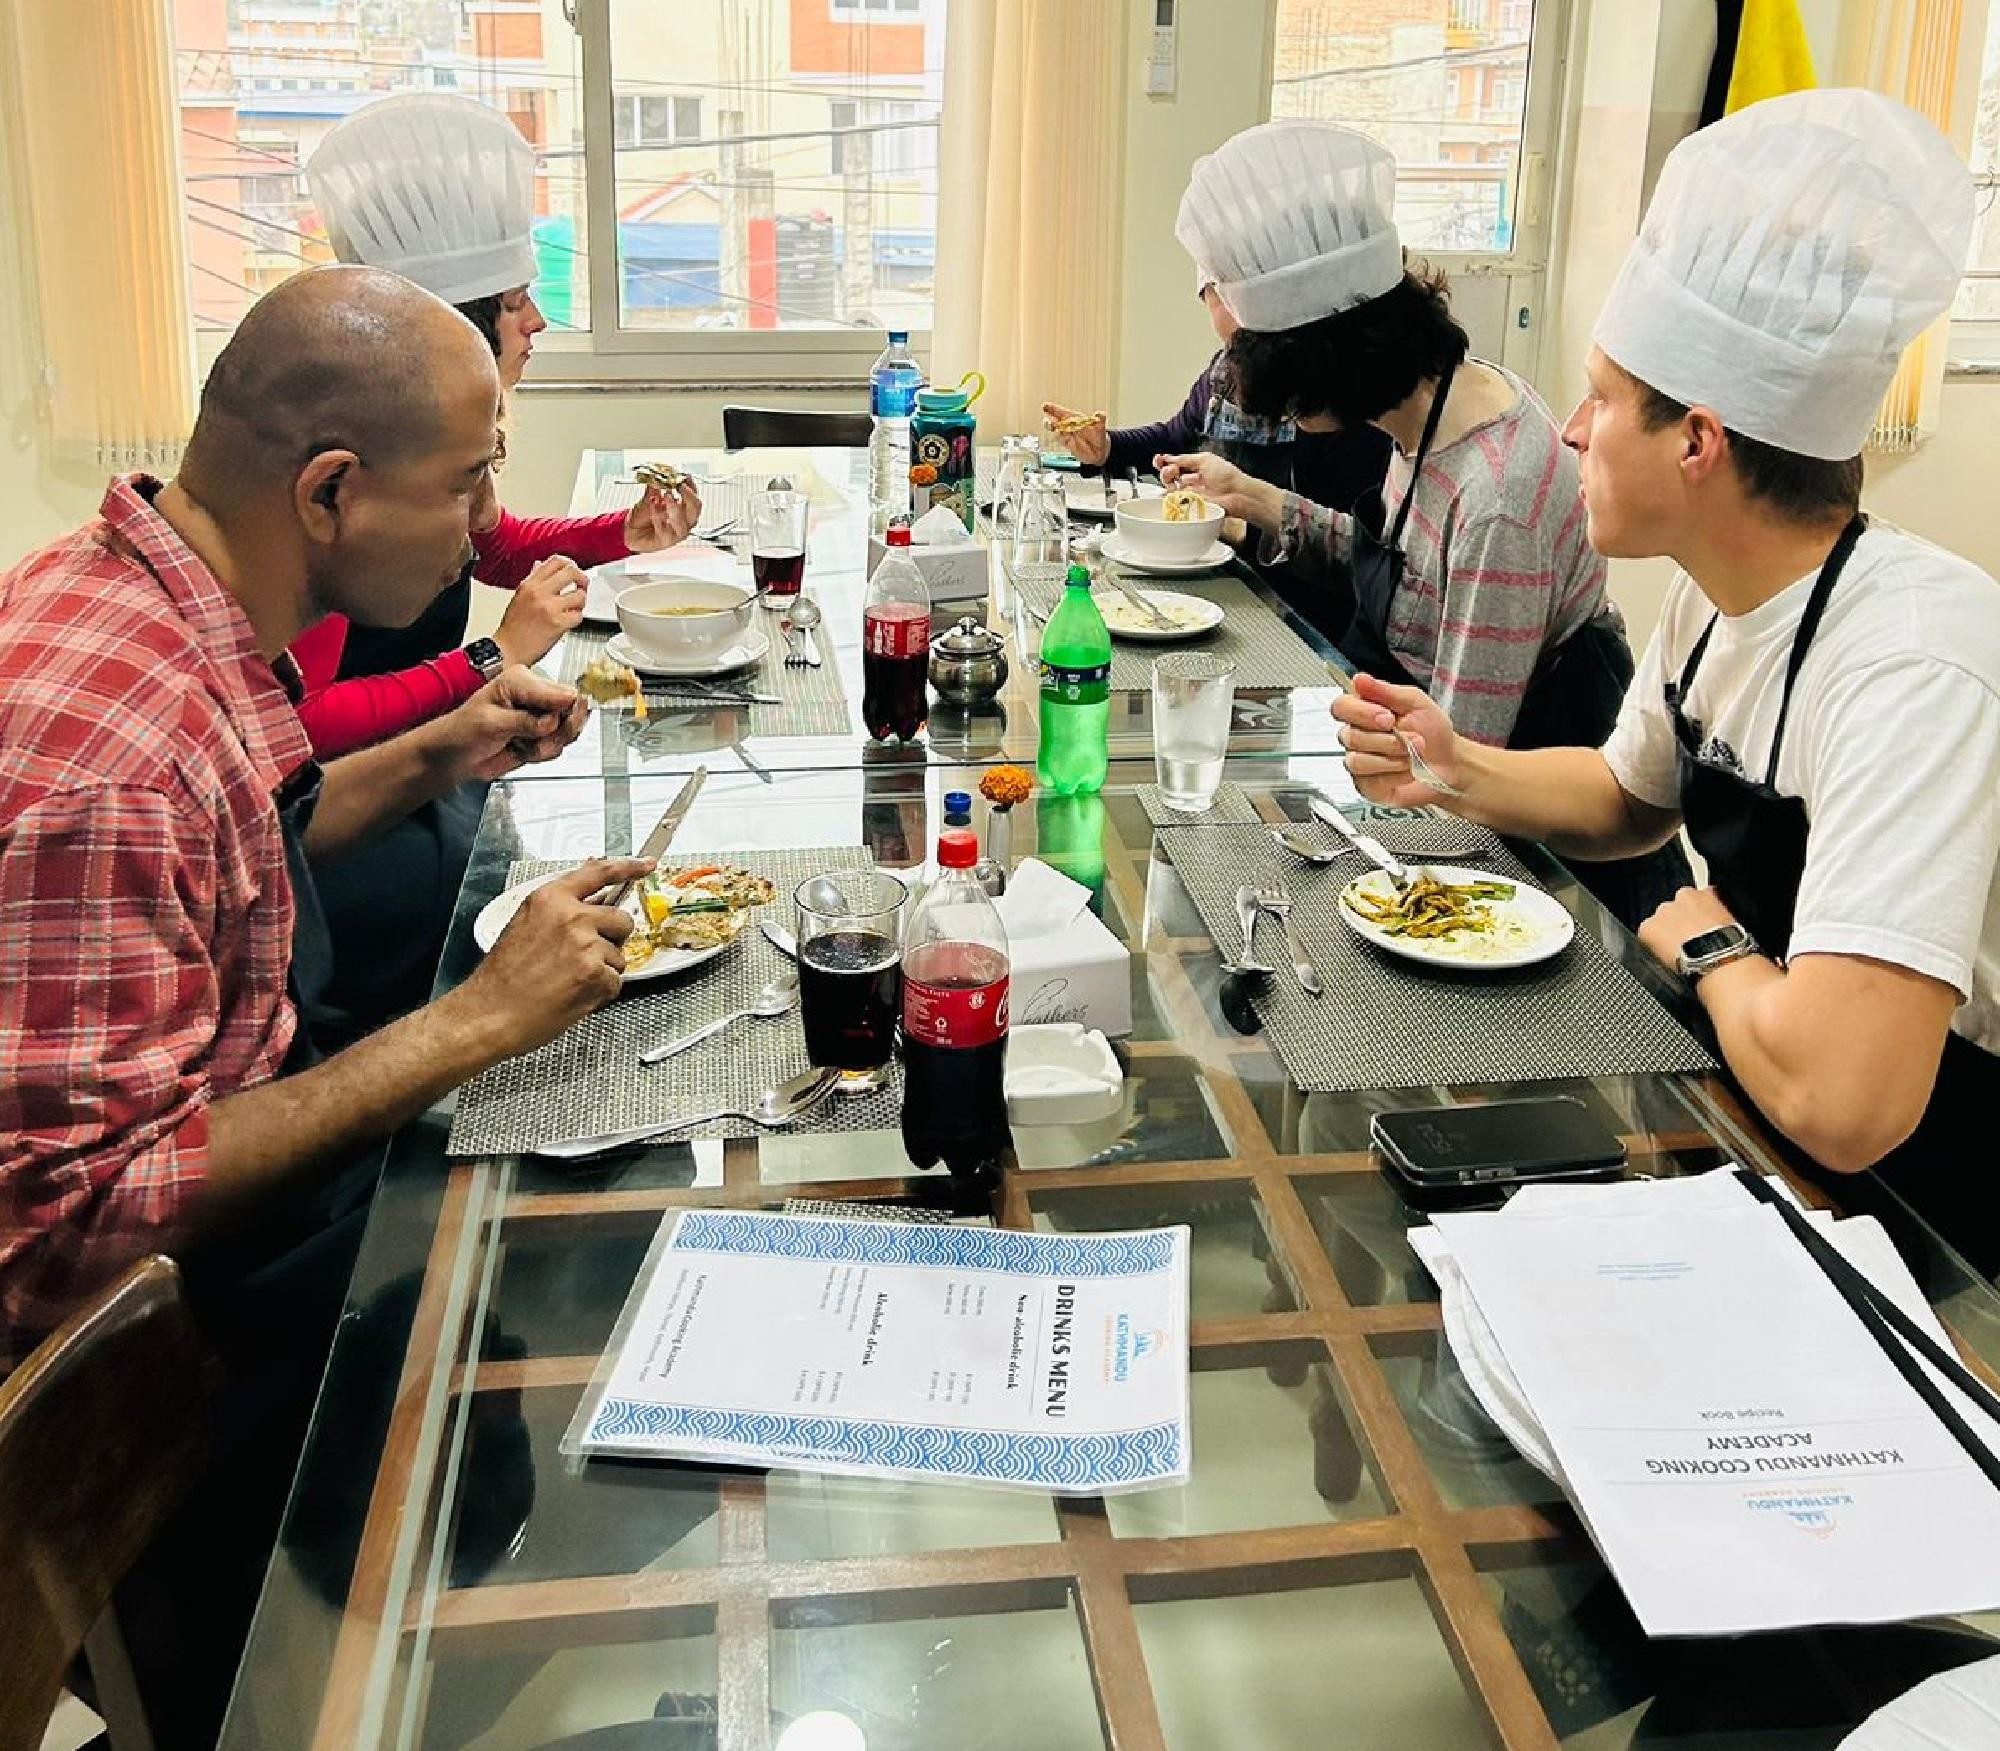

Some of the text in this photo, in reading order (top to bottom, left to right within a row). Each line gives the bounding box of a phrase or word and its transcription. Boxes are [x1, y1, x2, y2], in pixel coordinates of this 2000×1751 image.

[862, 1338, 878, 1366] drink
[1045, 1284, 1076, 1418] DRINKS MENU
[1006, 1361, 1021, 1389] drink
[1707, 1432, 1813, 1450] ACADEMY
[1645, 1449, 1904, 1475] KATHMANDU COOKING
